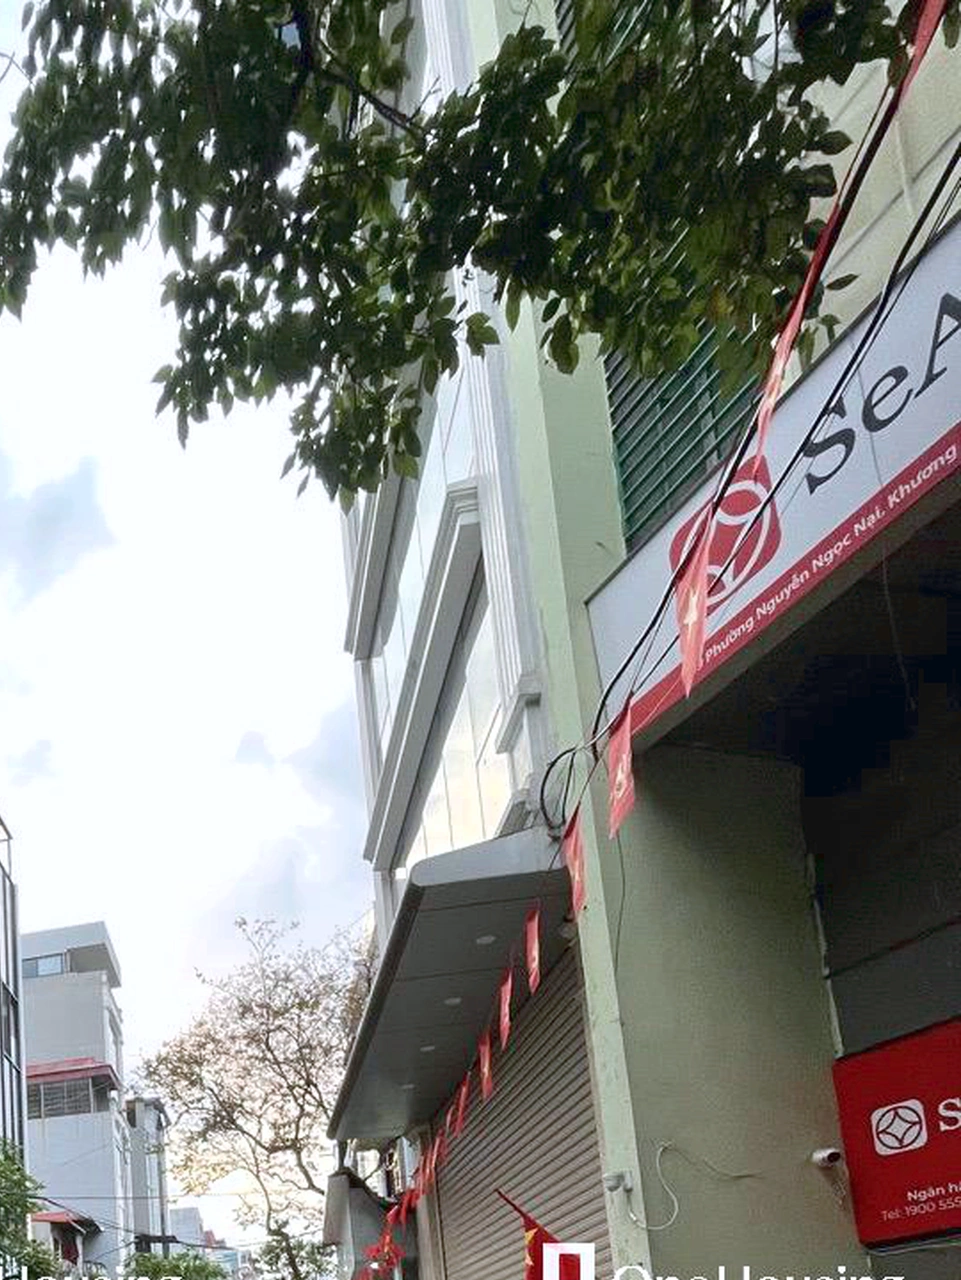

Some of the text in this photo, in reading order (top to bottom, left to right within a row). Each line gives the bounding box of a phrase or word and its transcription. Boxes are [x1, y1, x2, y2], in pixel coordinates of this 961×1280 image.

[755, 569, 810, 616] Nguyễn
[811, 535, 852, 573] Ngọc
[887, 444, 958, 508] Khương
[906, 1184, 945, 1202] Ngân
[904, 1201, 936, 1218] 1900
